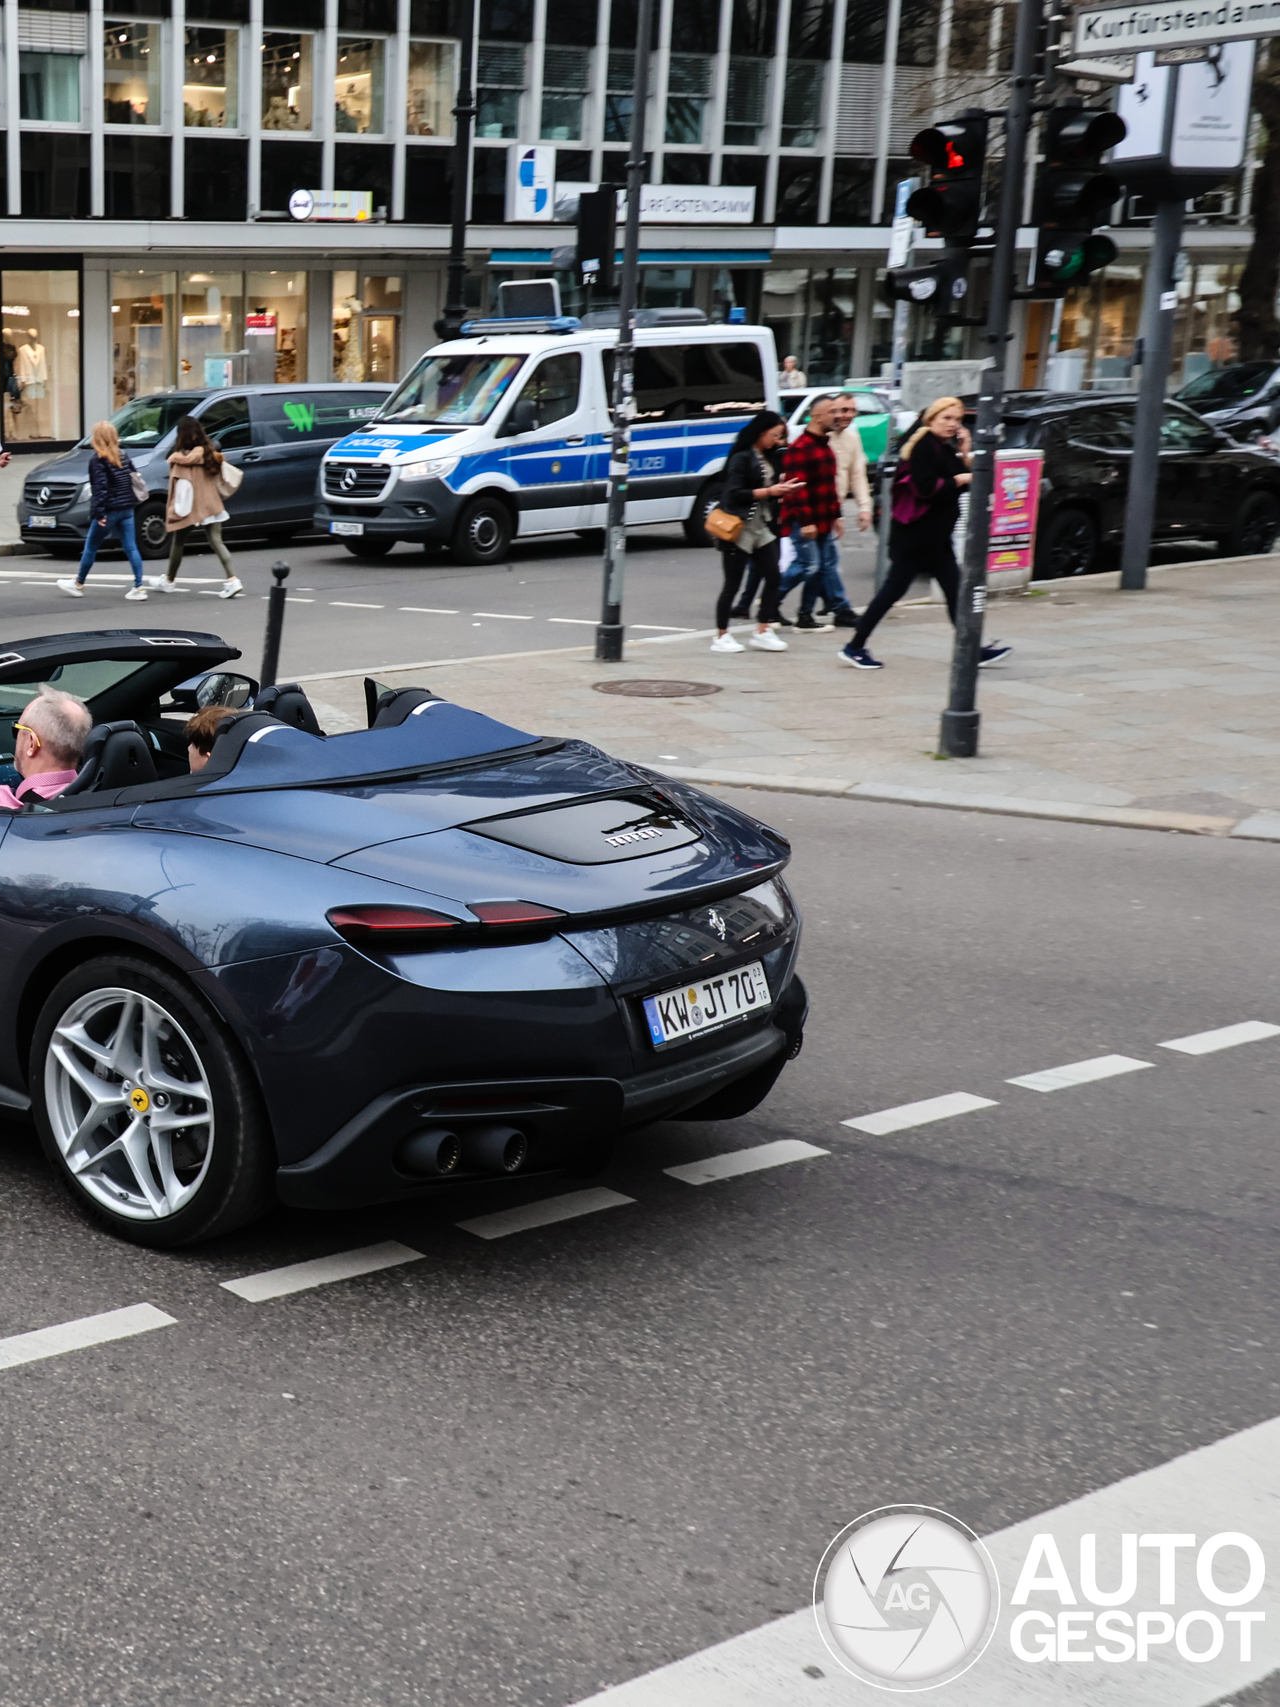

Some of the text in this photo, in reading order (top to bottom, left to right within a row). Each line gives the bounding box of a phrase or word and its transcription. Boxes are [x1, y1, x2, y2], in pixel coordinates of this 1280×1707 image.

[628, 195, 751, 213] URFÜRSTENDAMM
[344, 437, 404, 448] POLIZEI
[627, 456, 666, 471] OLIZEI
[605, 828, 663, 848] Ferrari
[658, 971, 756, 1035] KW JT 70
